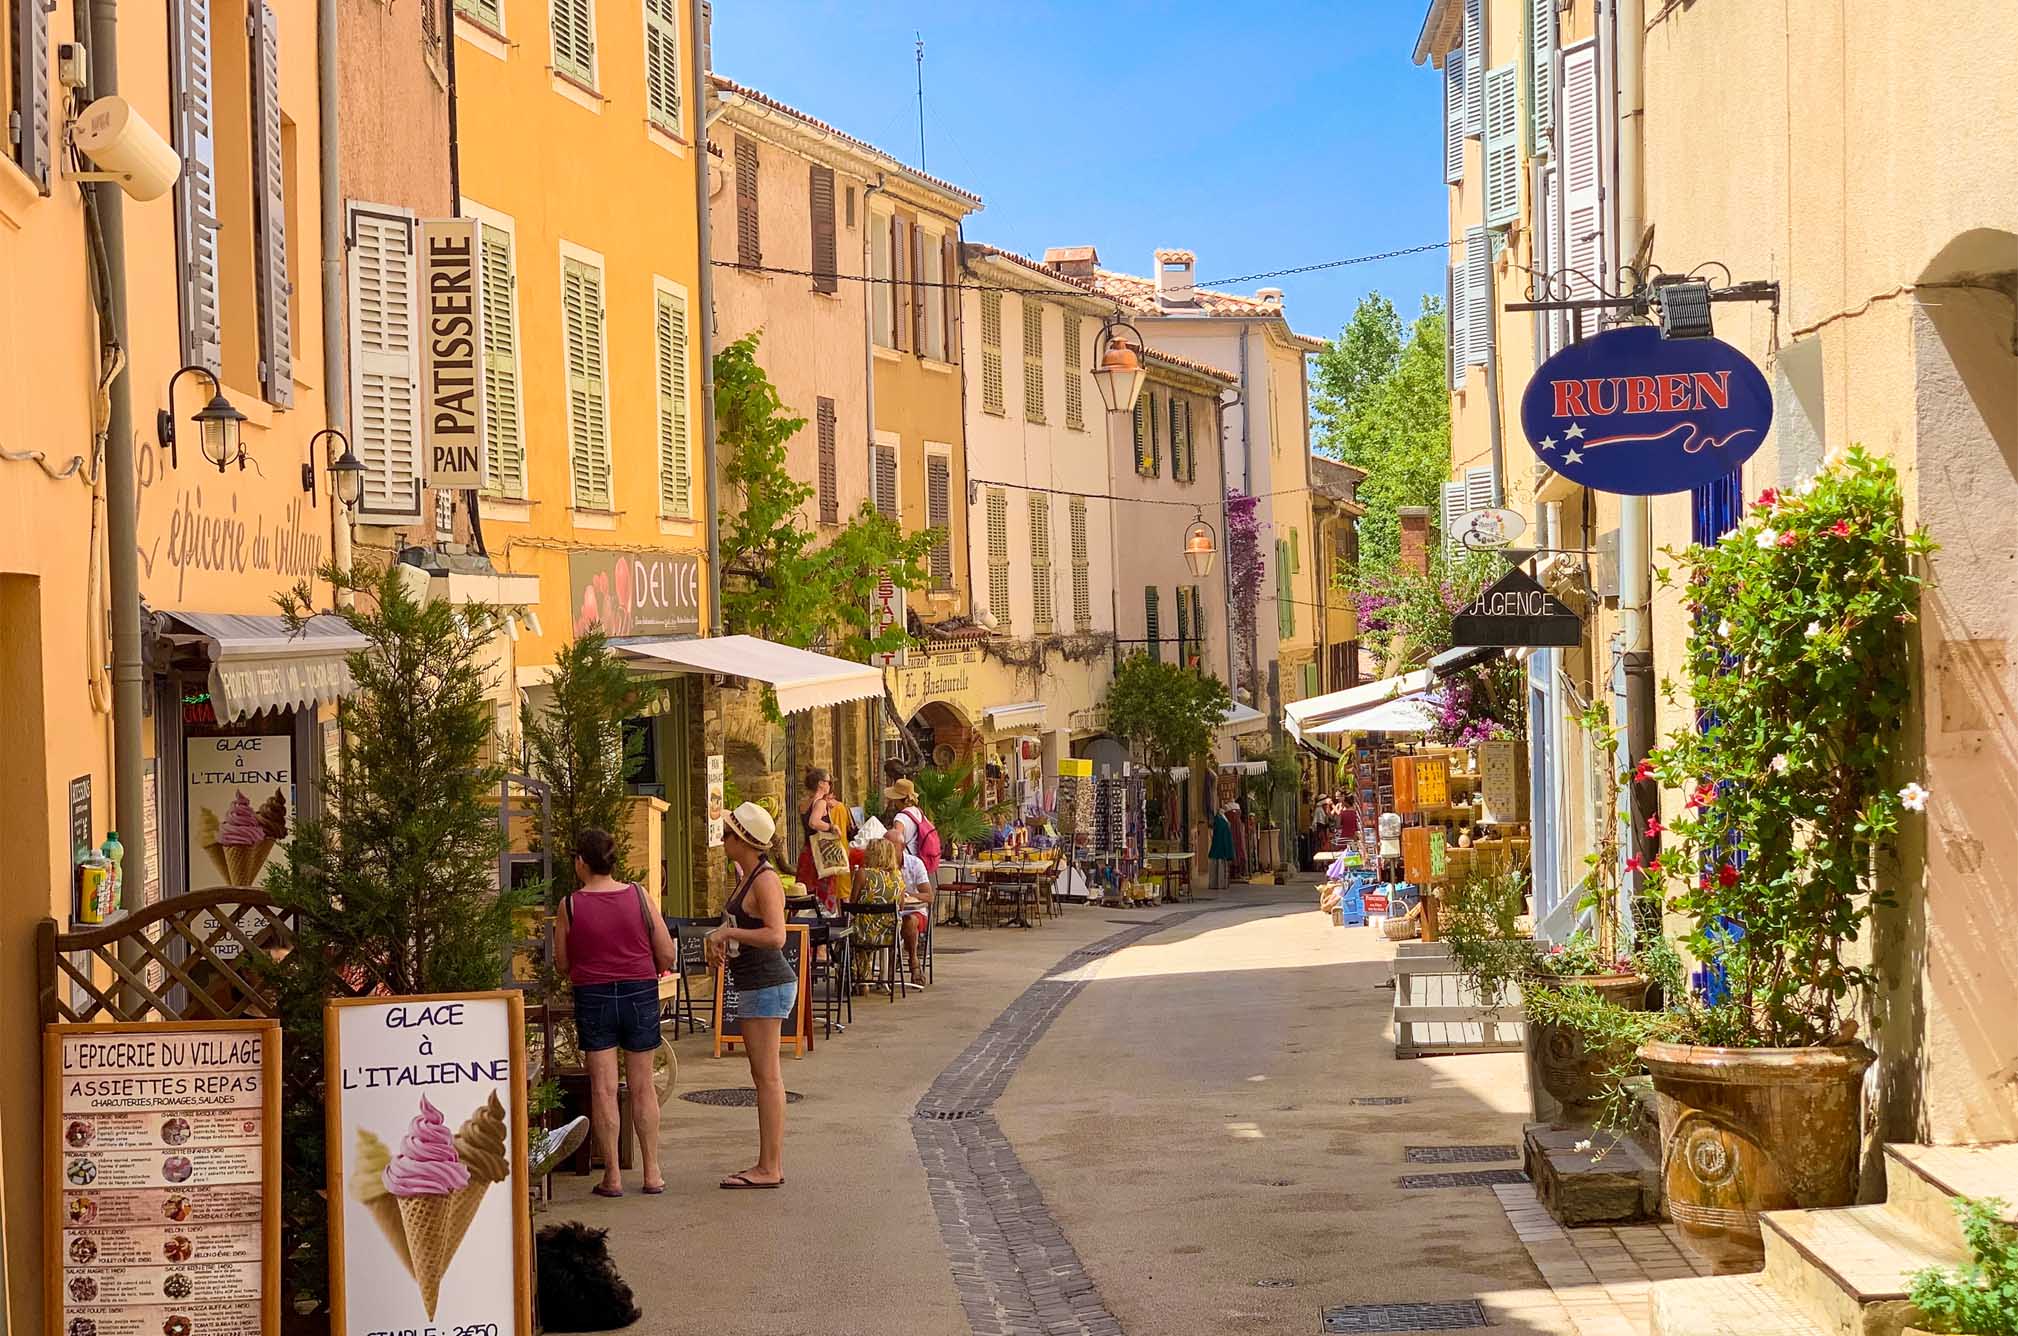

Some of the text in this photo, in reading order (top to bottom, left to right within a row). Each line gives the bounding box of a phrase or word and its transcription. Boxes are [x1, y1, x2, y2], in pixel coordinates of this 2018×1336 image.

[429, 237, 475, 435] PATISSERIE
[1551, 370, 1732, 418] RUBEN
[433, 446, 478, 472] PAIN
[253, 514, 270, 570] du
[635, 560, 697, 608] DEL'ICE
[1469, 591, 1554, 616] AGENCE
[216, 738, 263, 751] GLACE
[235, 754, 245, 768] à
[192, 770, 289, 784] L'ITALIENNE
[386, 1003, 464, 1028] GLACE
[64, 1039, 261, 1069] L'EPICERIE DU VILLAGE
[418, 1034, 433, 1056] à
[70, 1076, 257, 1097] ASSIETTES REPAS
[343, 1059, 508, 1089] L'ITALIENNE
